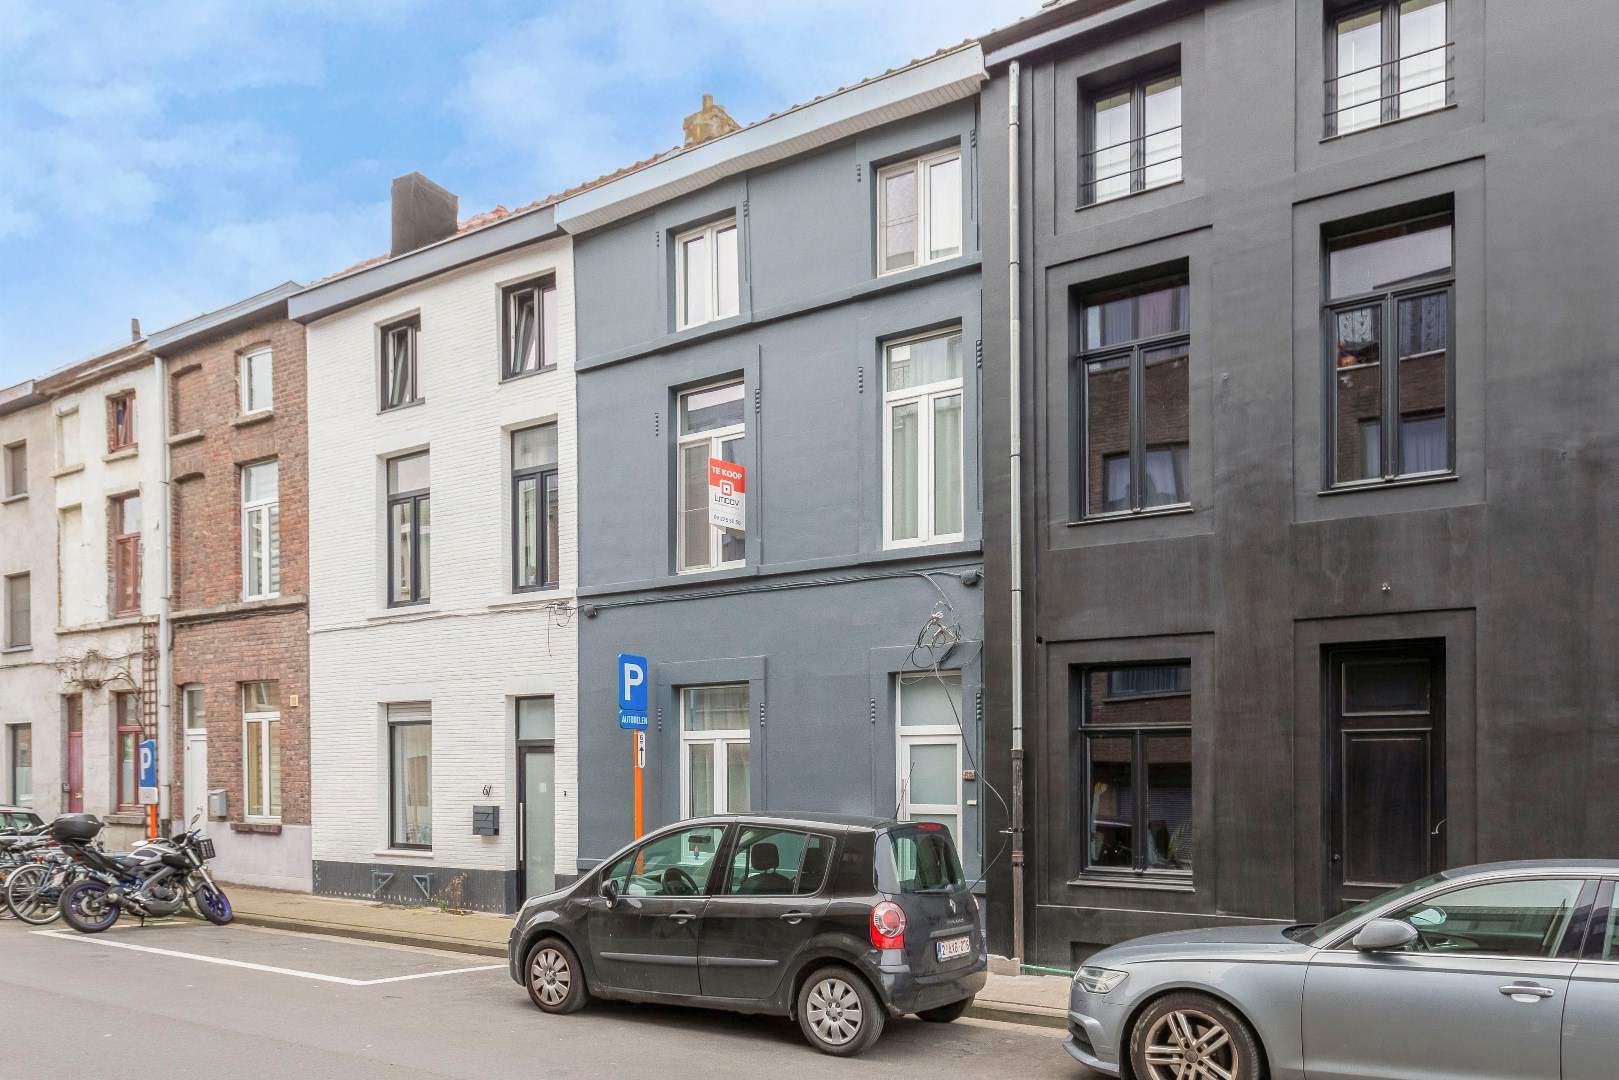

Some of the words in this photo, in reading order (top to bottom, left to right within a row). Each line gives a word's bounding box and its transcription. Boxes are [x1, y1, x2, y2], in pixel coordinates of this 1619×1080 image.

[711, 466, 721, 475] TE
[721, 469, 742, 480] KOOP
[624, 662, 644, 700] P
[621, 715, 648, 725] AUTODELEN
[140, 747, 152, 780] P
